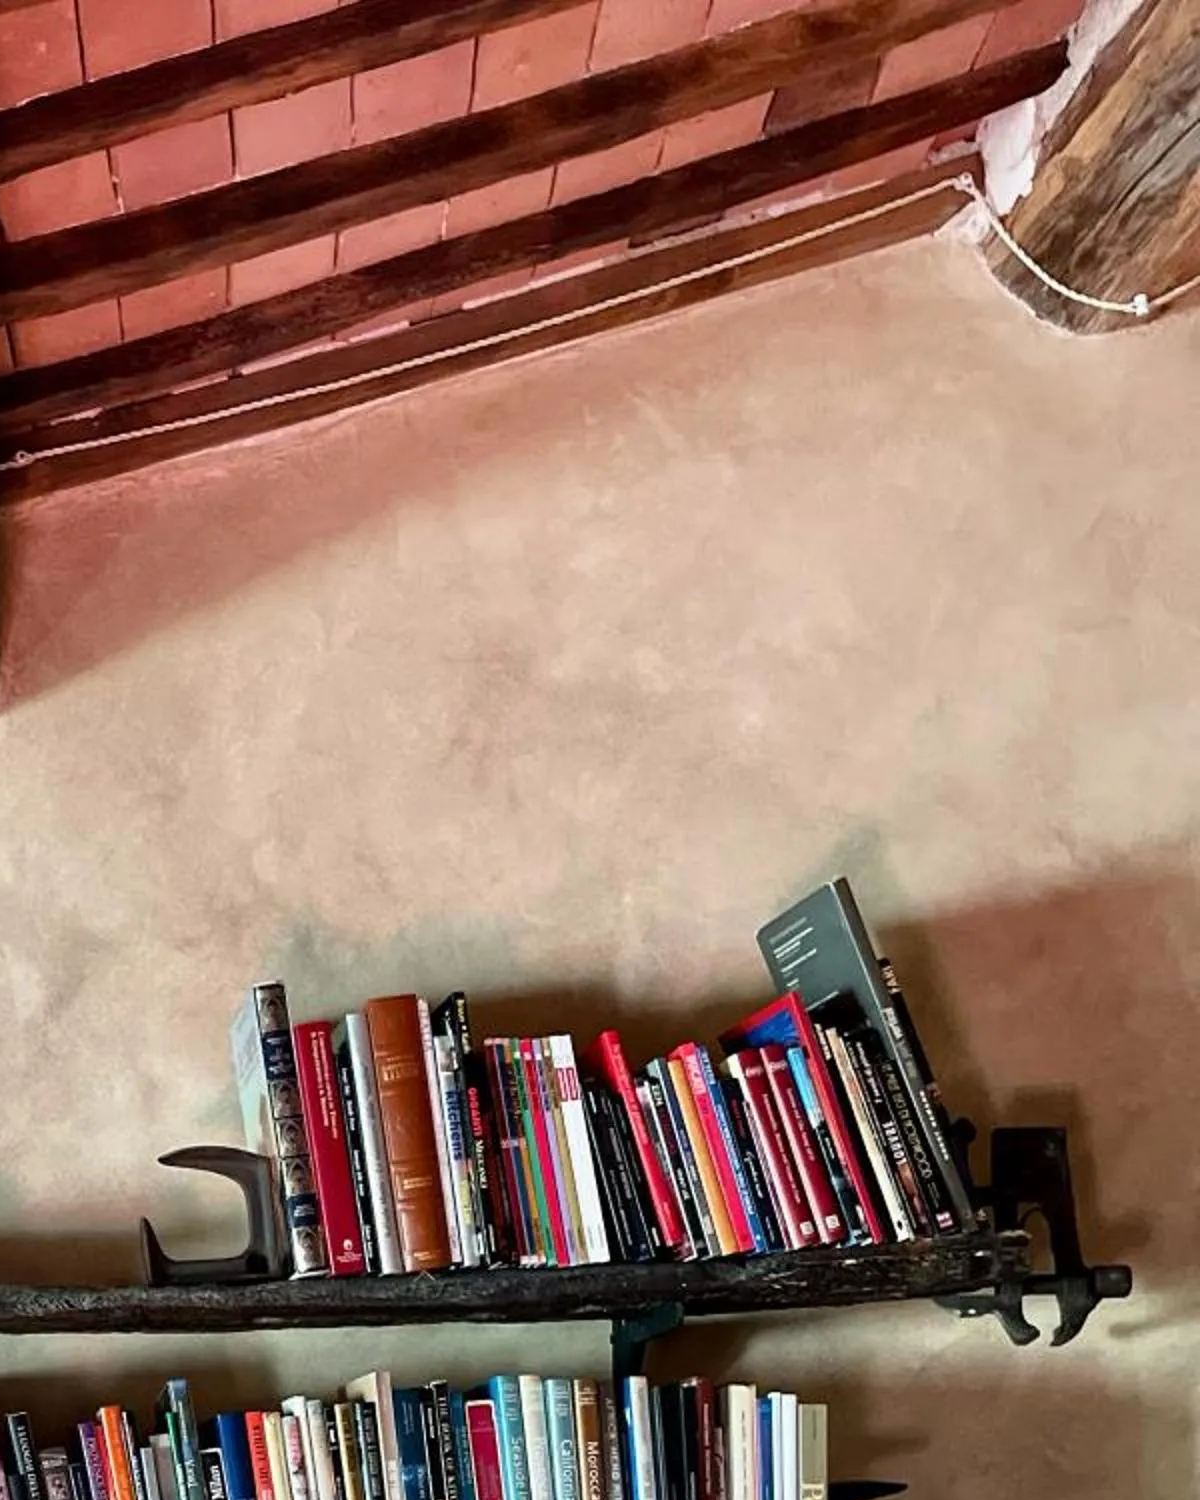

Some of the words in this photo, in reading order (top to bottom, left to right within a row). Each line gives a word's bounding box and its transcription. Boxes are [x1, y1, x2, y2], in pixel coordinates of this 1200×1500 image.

[444, 1089, 466, 1161] kitchens
[881, 1119, 907, 1166] LOUVRE
[437, 1395, 449, 1416] THE
[441, 1421, 454, 1453] BOOK
[445, 1456, 456, 1471] OF
[510, 1436, 528, 1489] Seaside
[206, 1464, 225, 1500] Milan
